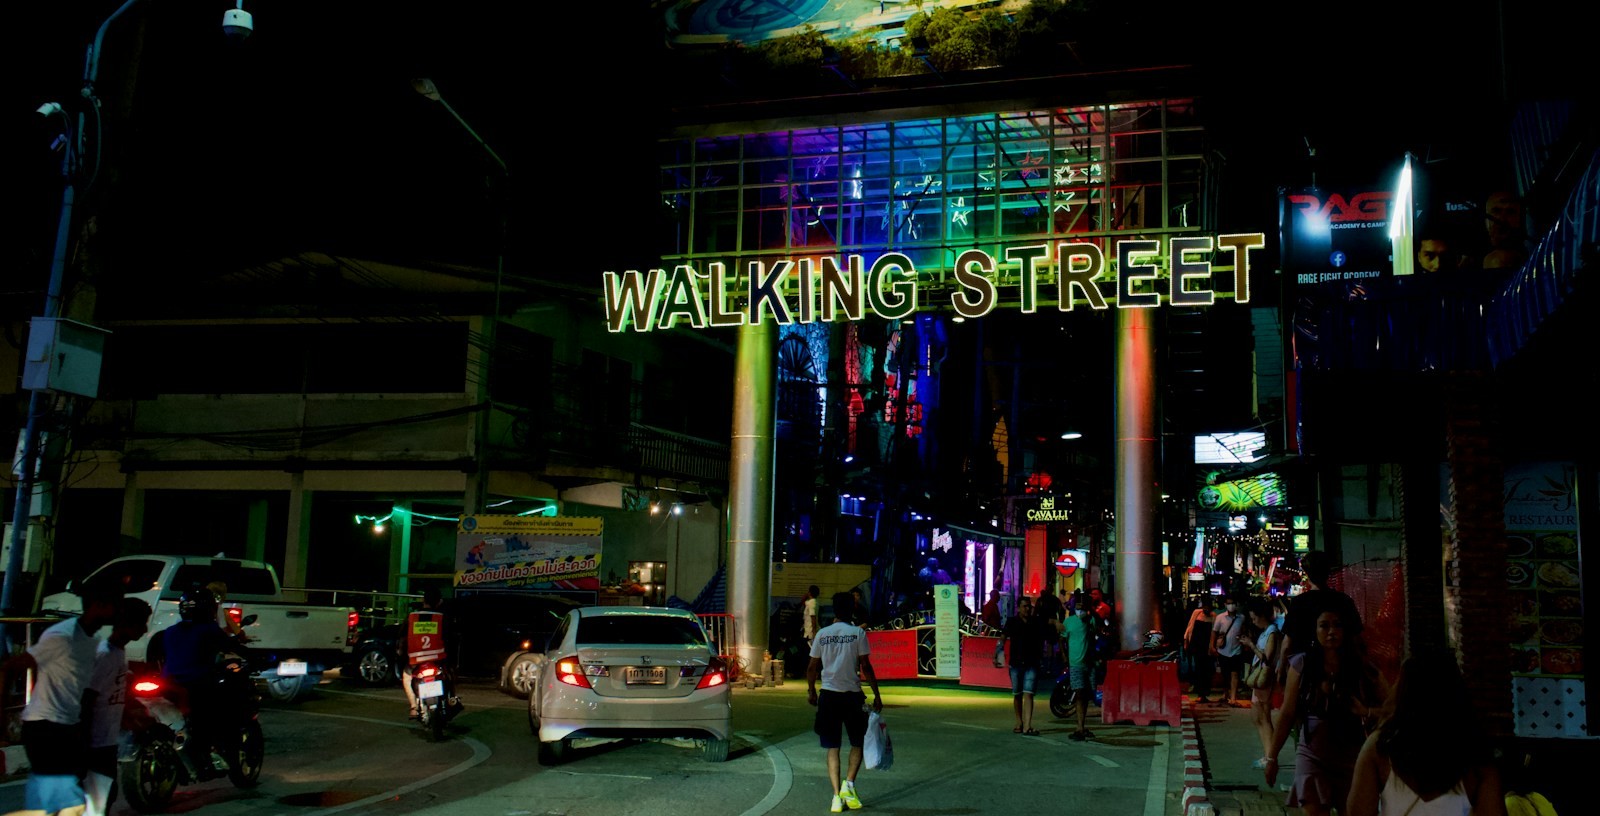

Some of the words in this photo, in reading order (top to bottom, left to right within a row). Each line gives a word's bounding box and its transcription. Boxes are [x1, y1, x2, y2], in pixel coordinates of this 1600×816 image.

[1287, 191, 1394, 223] RAG
[1329, 222, 1361, 230] ACADEMY
[1367, 221, 1386, 229] CAMP
[603, 252, 917, 332] WALKING
[951, 233, 1265, 318] STREET
[1297, 273, 1318, 284] RAGE
[1320, 272, 1342, 283] FIGHT
[1026, 509, 1069, 519] CAVALLI
[460, 559, 597, 585] ขออภัยในความไม่สะดวก
[507, 578, 526, 587] Sorry
[527, 577, 537, 585] for
[538, 575, 549, 583] the
[549, 570, 599, 582] inconvenience
[422, 635, 431, 649] 2
